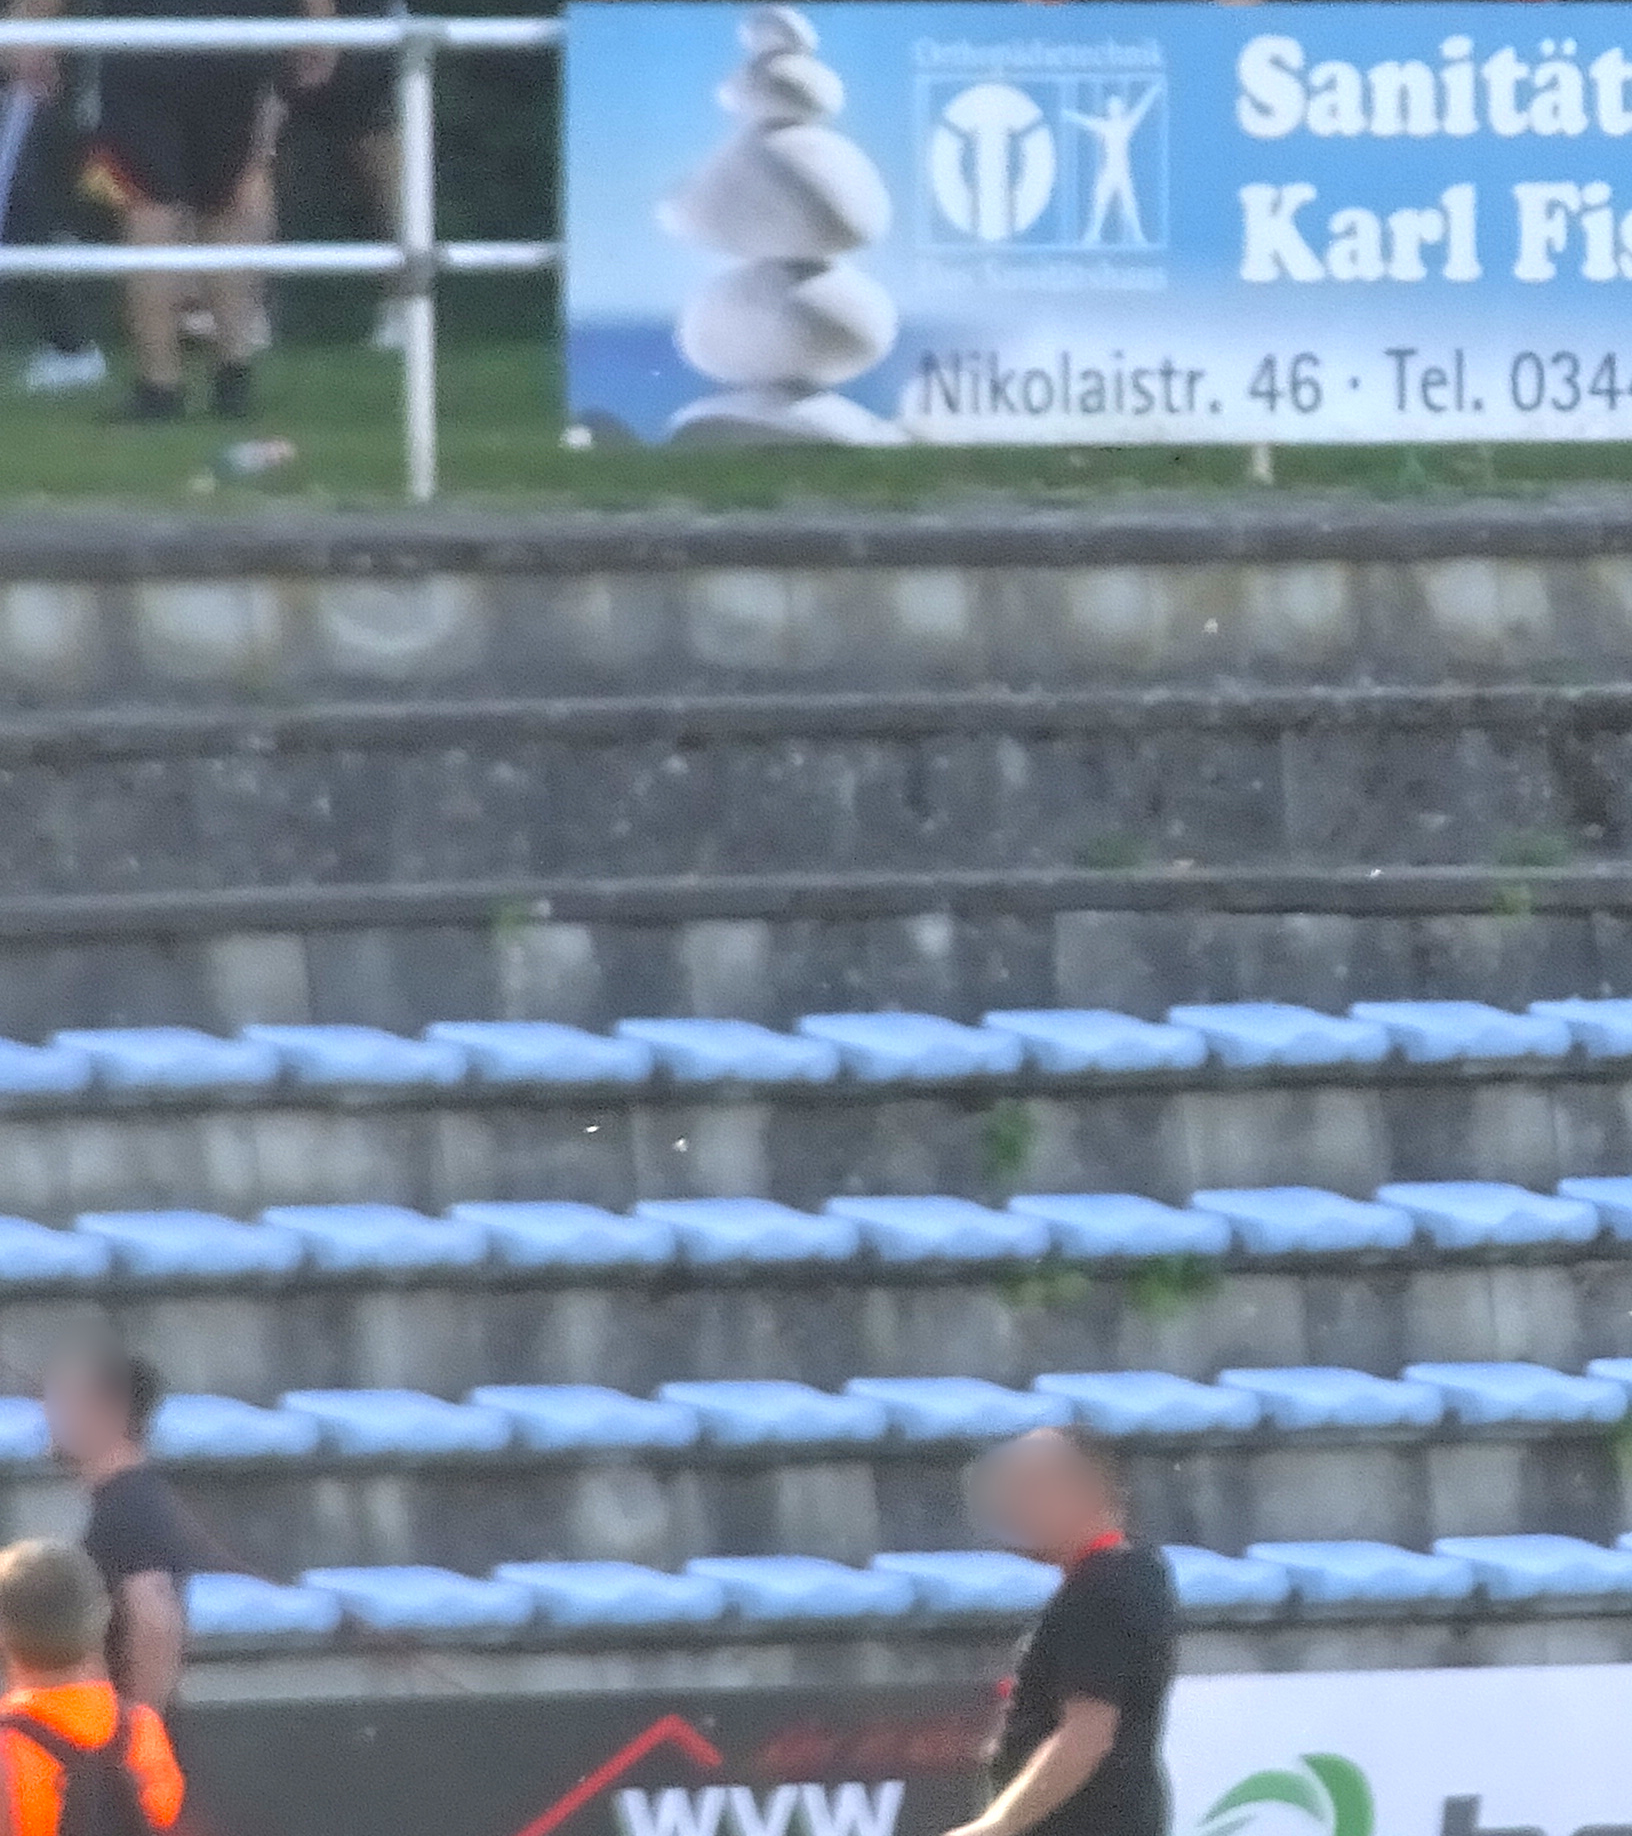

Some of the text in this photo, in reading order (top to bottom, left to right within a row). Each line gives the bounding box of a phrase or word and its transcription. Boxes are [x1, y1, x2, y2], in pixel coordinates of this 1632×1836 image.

[1238, 182, 1482, 282] Karl
[920, 350, 1222, 416] Nikolaistr.
[1249, 352, 1324, 413] 46
[1382, 346, 1484, 413] Tel.
